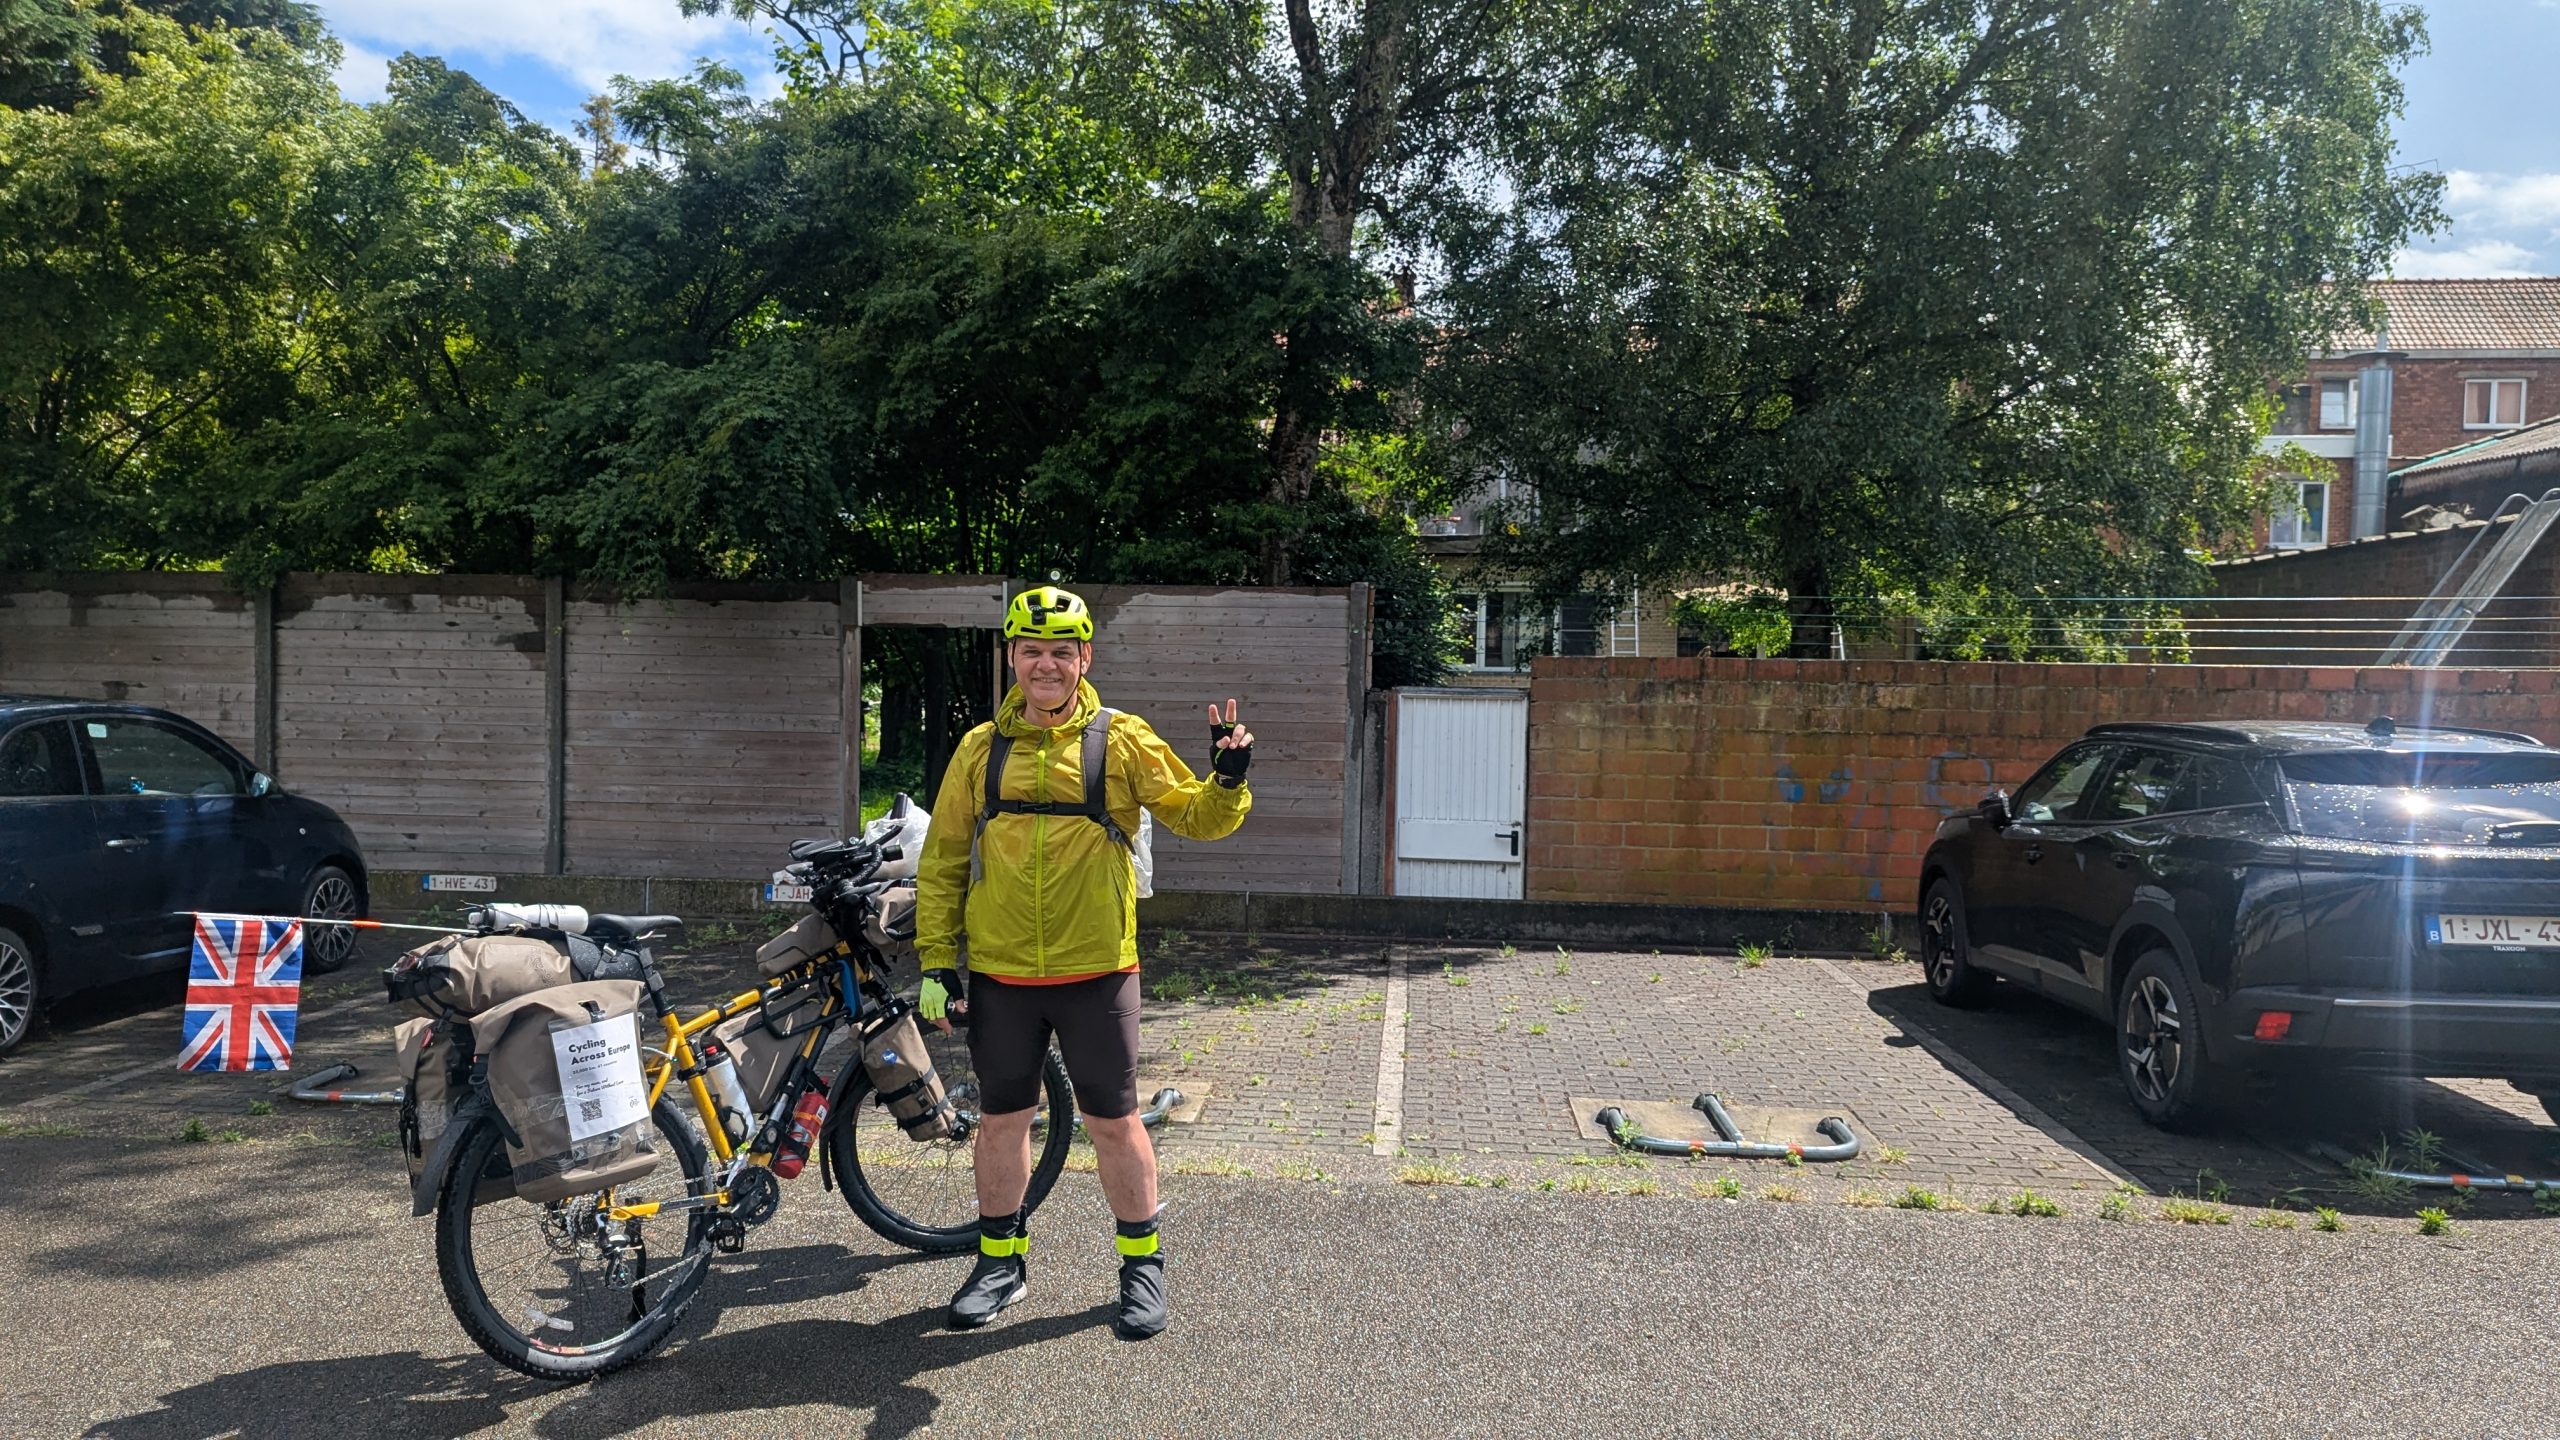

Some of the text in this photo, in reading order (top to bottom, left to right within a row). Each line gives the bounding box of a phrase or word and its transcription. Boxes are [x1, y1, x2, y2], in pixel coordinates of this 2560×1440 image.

[431, 877, 495, 890] 1-HVE-431
[568, 1040, 606, 1053] Cycling
[571, 1044, 630, 1065] Across Europe
